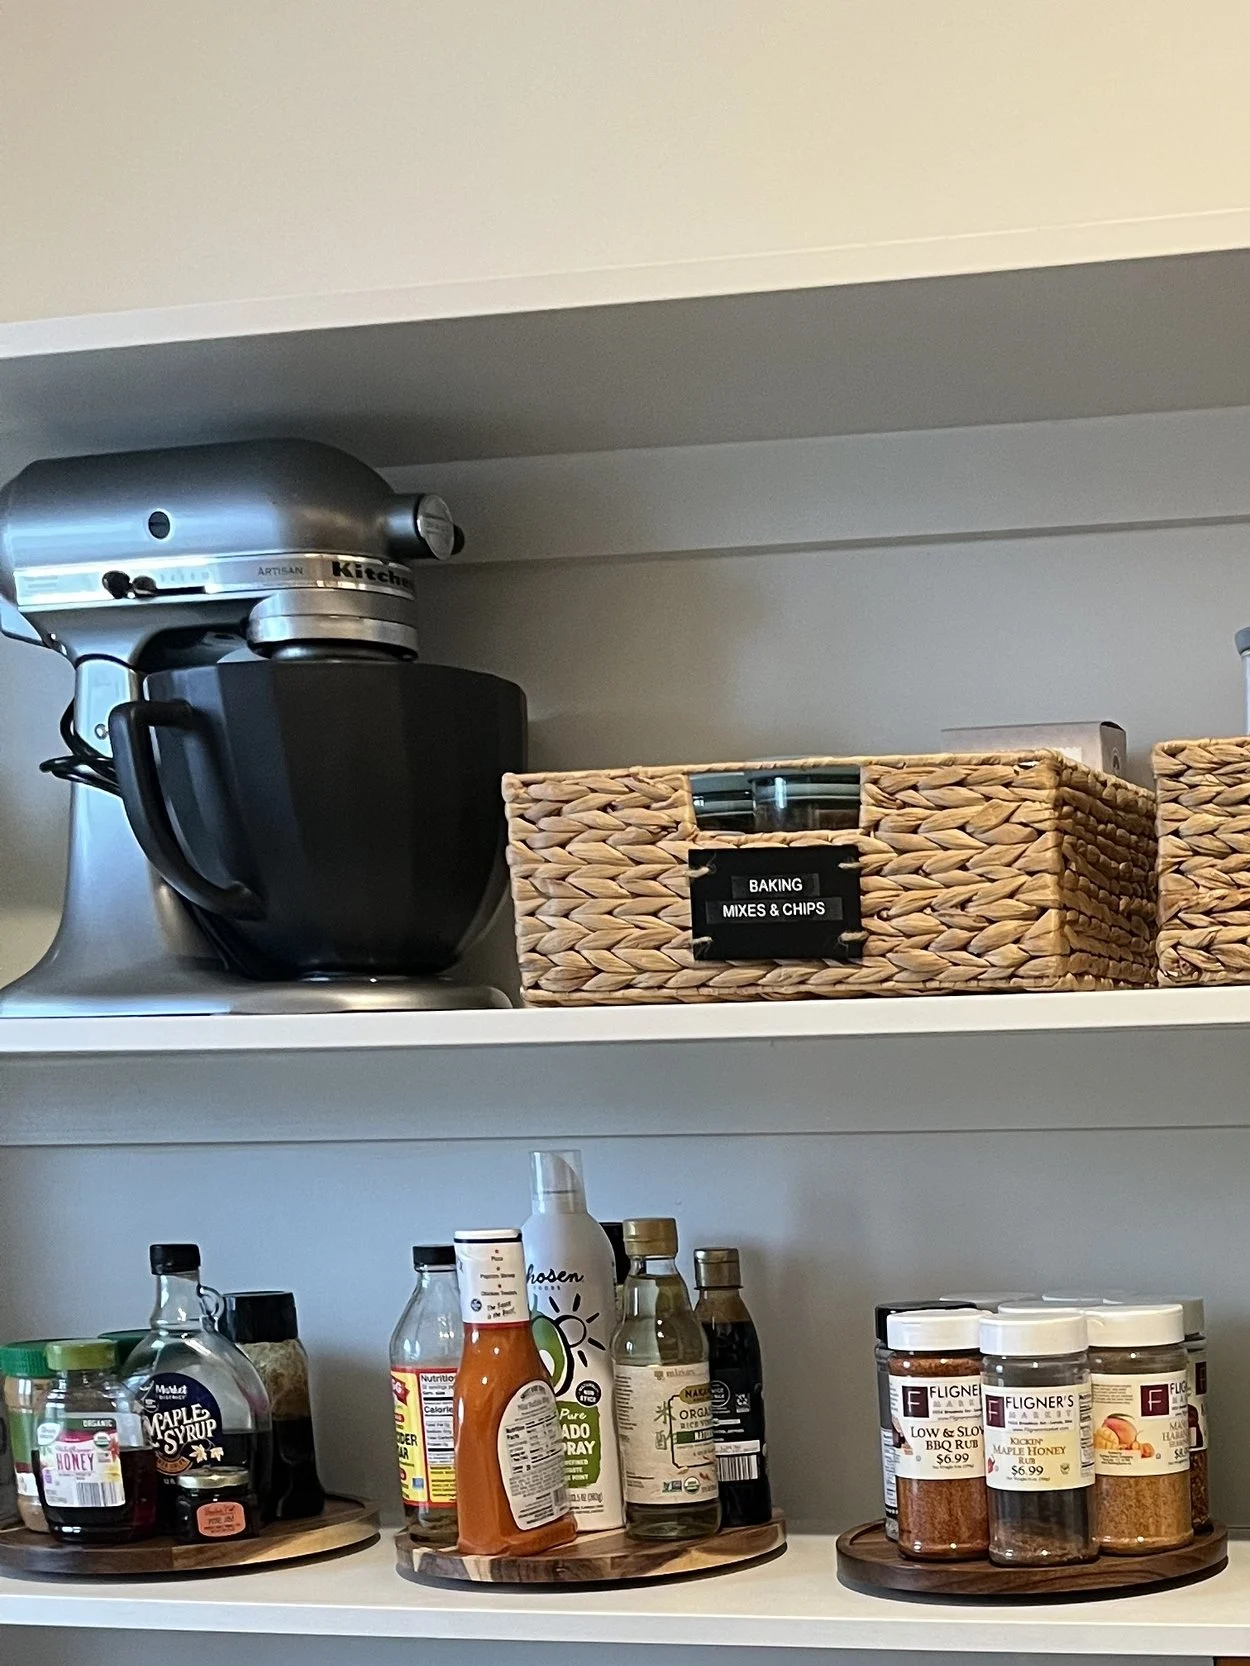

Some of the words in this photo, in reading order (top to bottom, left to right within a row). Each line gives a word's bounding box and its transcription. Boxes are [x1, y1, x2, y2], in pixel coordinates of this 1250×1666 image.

[258, 567, 304, 576] ARTISAN
[749, 877, 803, 893] BAKING
[723, 903, 766, 918] MIXES
[770, 903, 780, 917] &
[783, 901, 826, 916] CHIPS
[1006, 1395, 1074, 1410] FLIGNER'S
[560, 1408, 587, 1421] Pure
[144, 1403, 210, 1443] MAPLE
[164, 1419, 217, 1455] SYRUP
[911, 1427, 940, 1438] LOW
[943, 1428, 955, 1438] &
[926, 1440, 952, 1452] BBQ
[955, 1440, 979, 1450] RUB
[993, 1445, 1024, 1456] MAPLE
[1028, 1446, 1066, 1456] HONEY
[56, 1453, 95, 1472] HONEY
[936, 1453, 970, 1465] $6.99
[1011, 1465, 1045, 1476] $6.99
